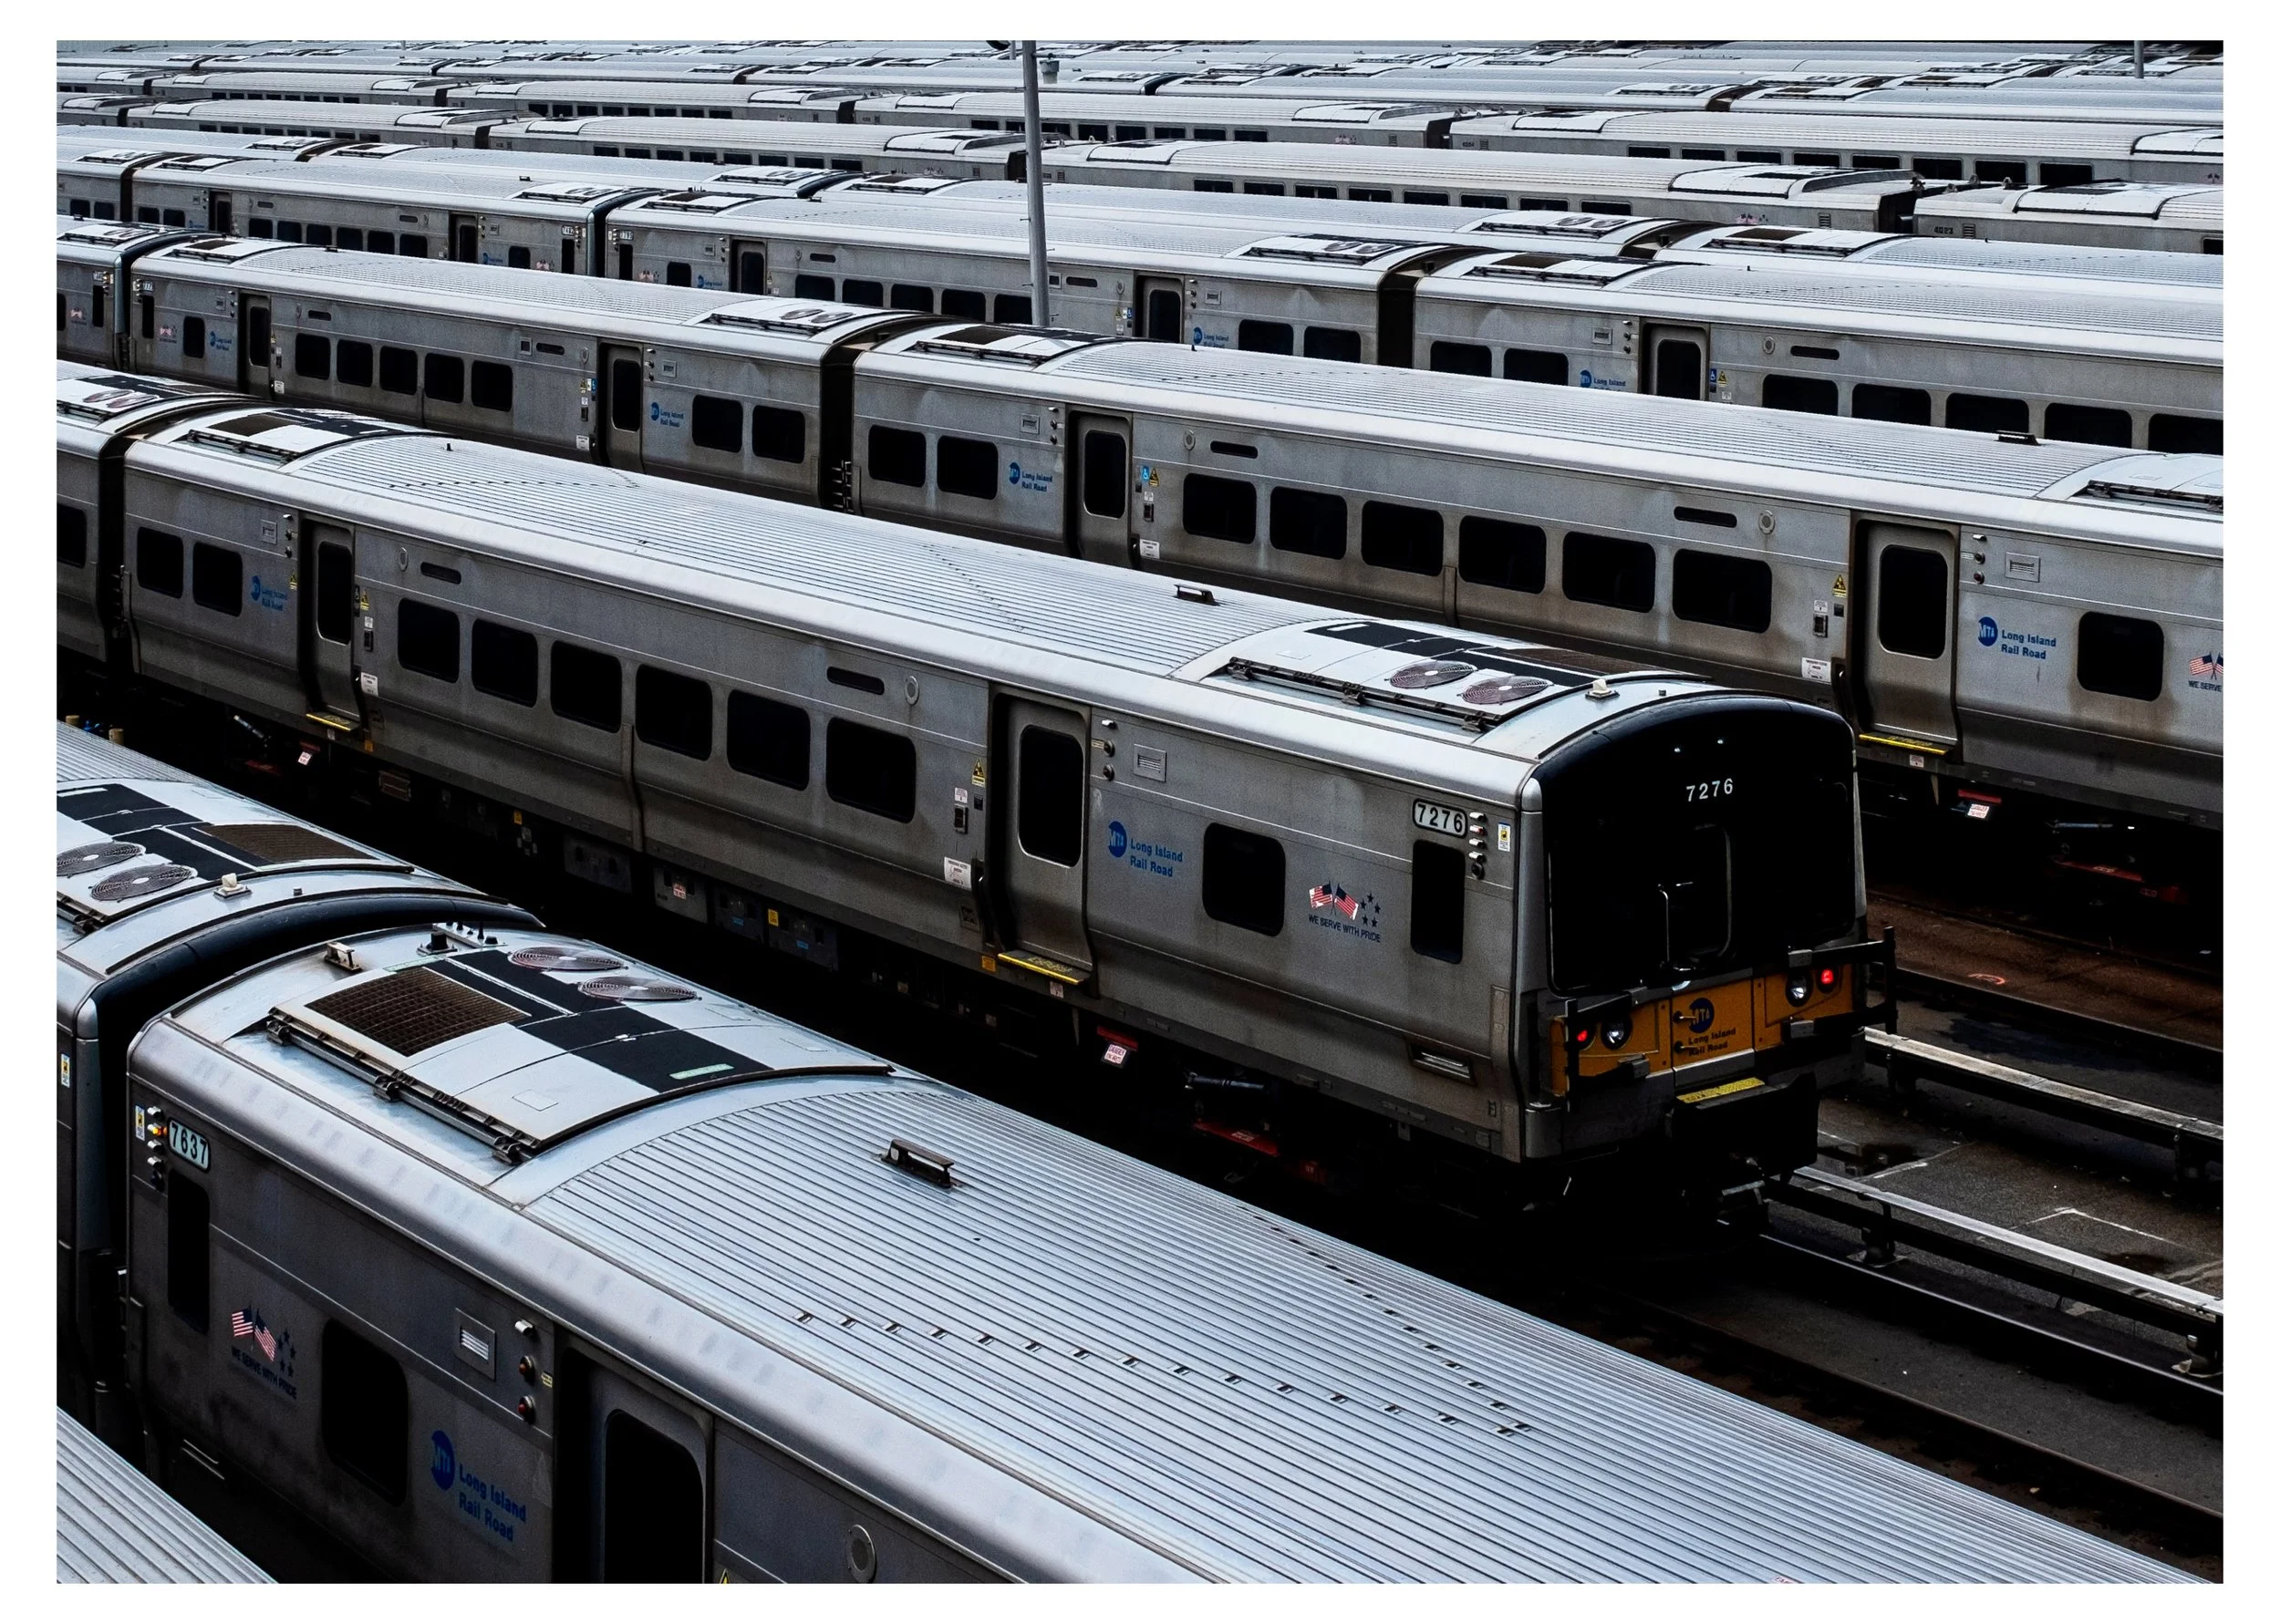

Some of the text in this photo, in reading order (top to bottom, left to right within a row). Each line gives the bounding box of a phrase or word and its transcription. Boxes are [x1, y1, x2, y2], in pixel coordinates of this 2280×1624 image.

[2001, 628, 2057, 647] Long Island
[2001, 643, 2047, 659] Rail Road
[1685, 778, 1734, 802] 7276
[1417, 802, 1463, 833] 7276
[1130, 837, 1184, 863] Long Island
[1130, 854, 1174, 877] Rail Road
[1308, 913, 1381, 943] WE SERVE WITH PRIDE
[1688, 1027, 1737, 1046] Long Island
[1707, 1040, 1729, 1053] Road
[171, 1122, 207, 1165] 7637
[232, 1345, 297, 1401] WE SERVE WITH PRIDE
[459, 1463, 526, 1523] Long Island
[459, 1491, 513, 1543] Rail Road
